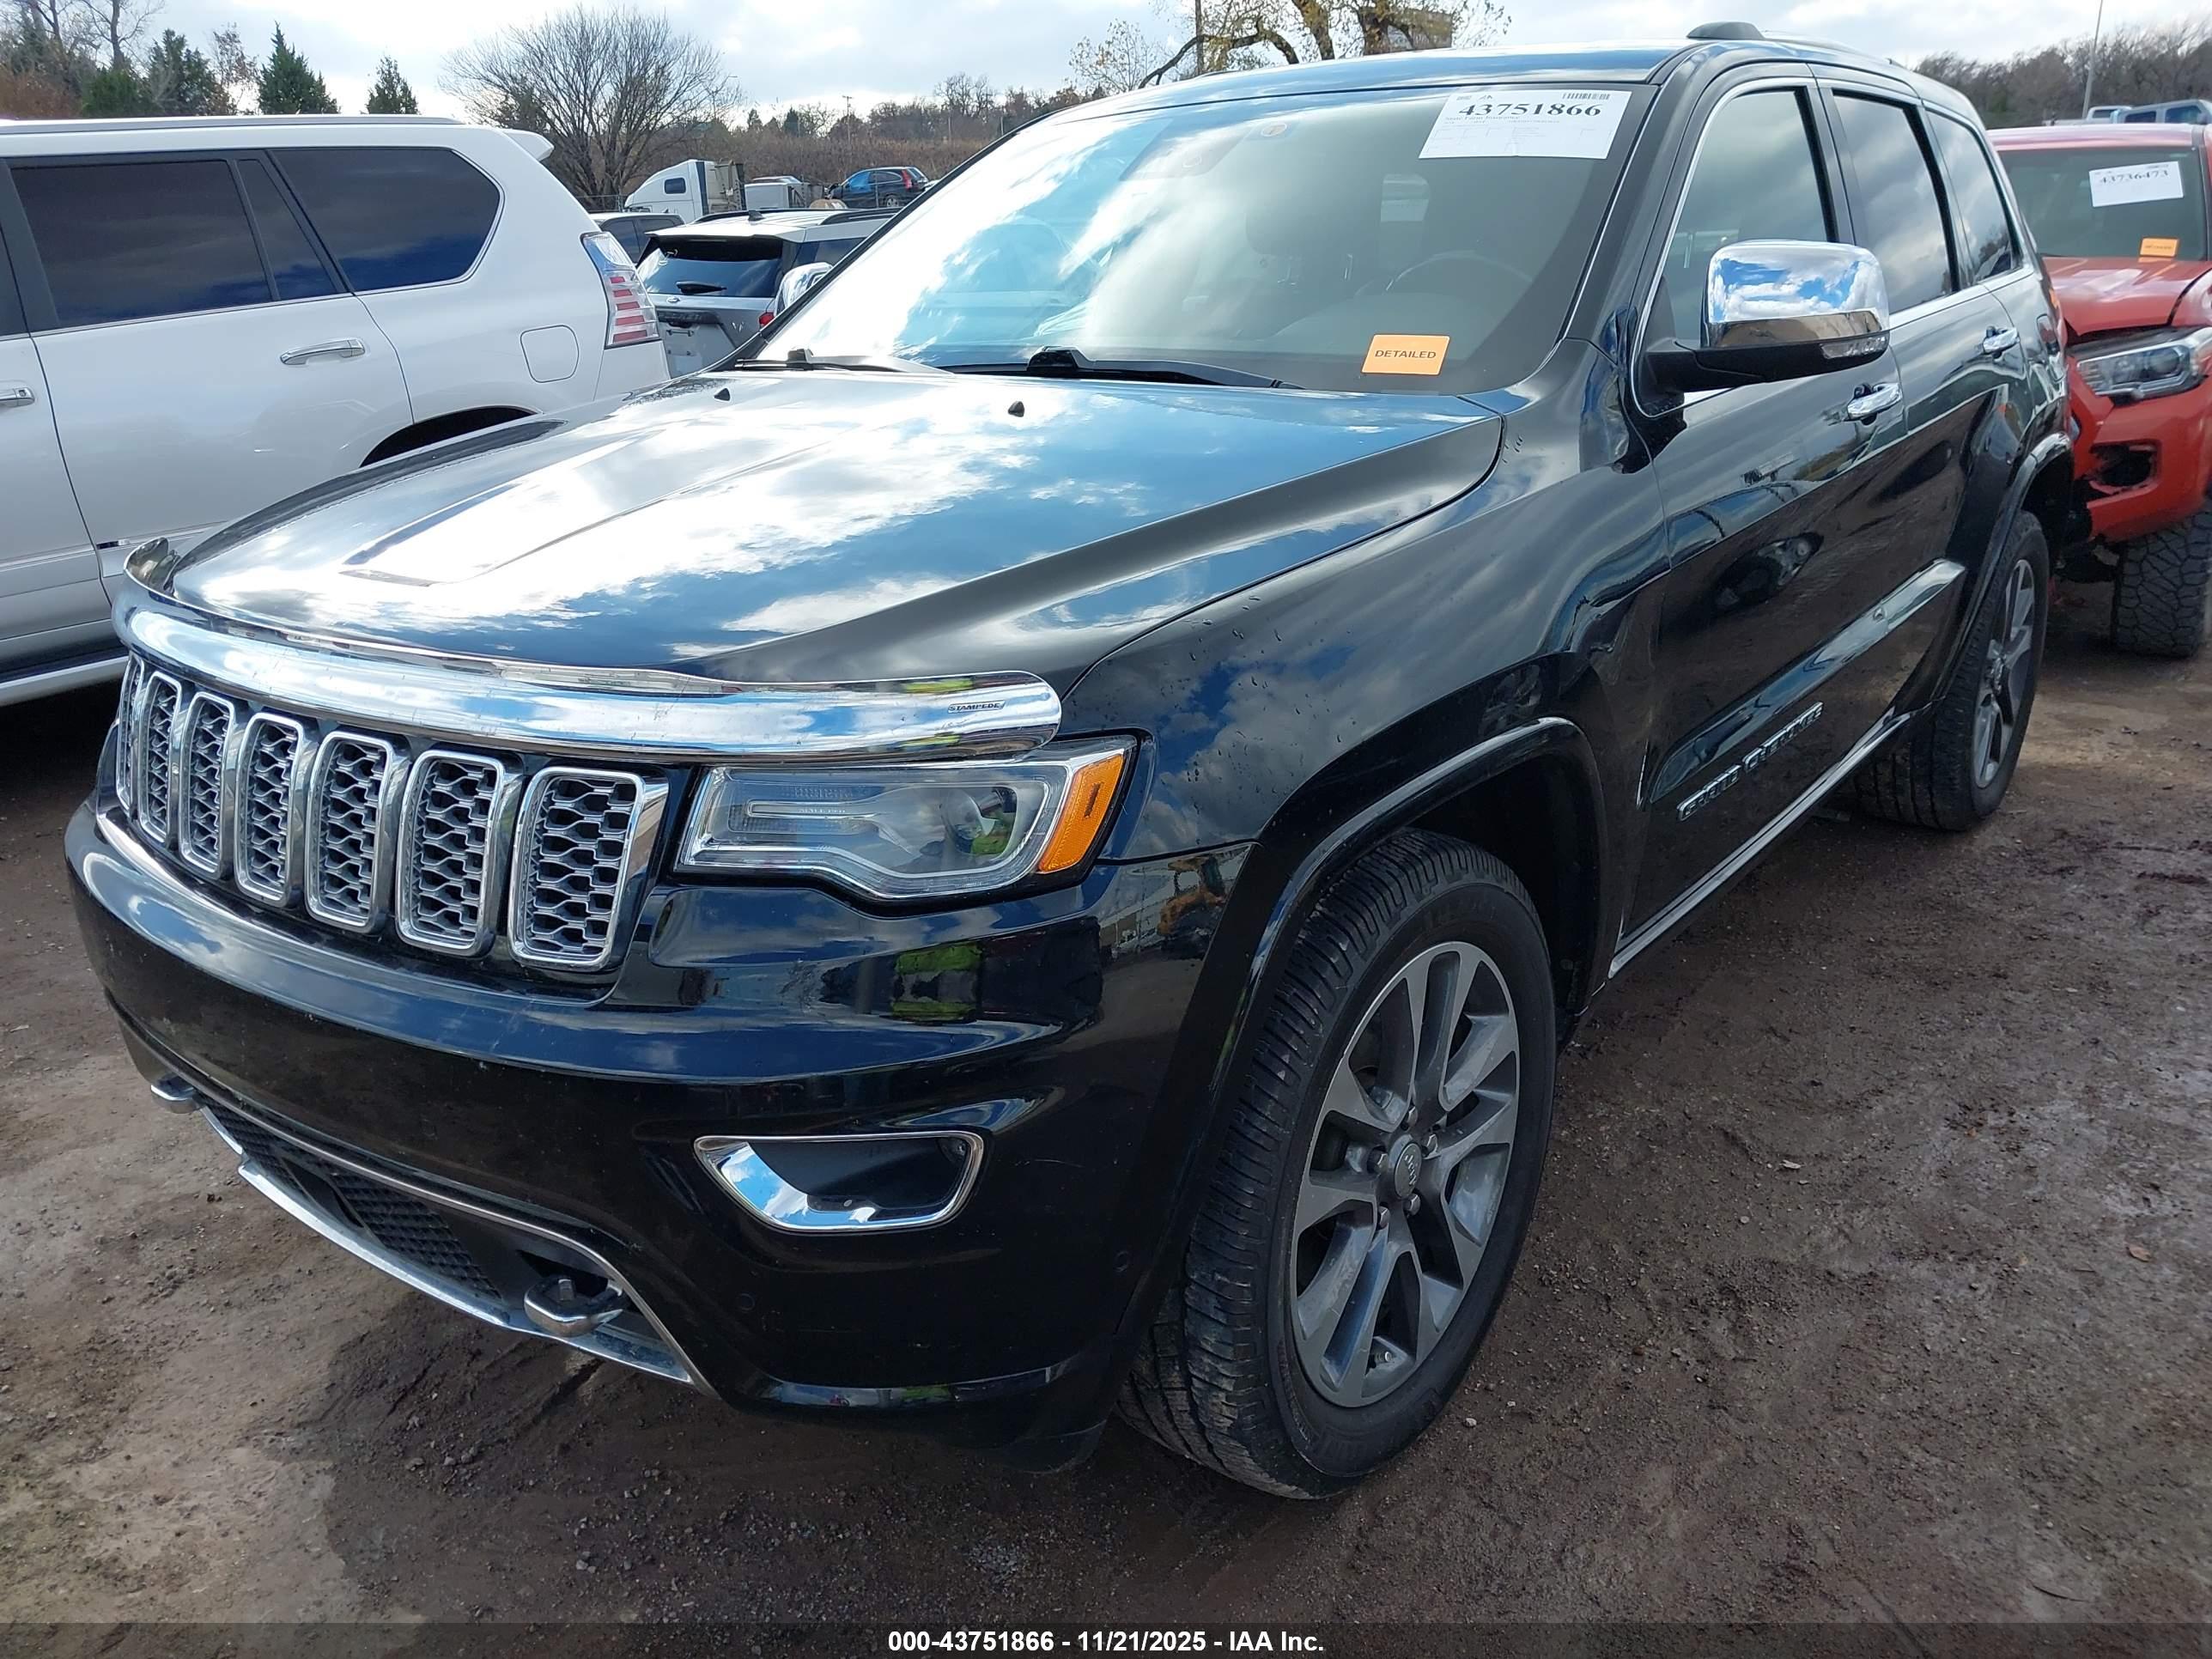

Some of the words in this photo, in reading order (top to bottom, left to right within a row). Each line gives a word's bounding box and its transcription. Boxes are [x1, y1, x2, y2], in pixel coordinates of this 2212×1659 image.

[1458, 103, 1601, 117] 43751866
[2100, 170, 2168, 184] 43736473
[1375, 349, 1437, 359] DETAILED
[950, 702, 1001, 711] STAMPEDE
